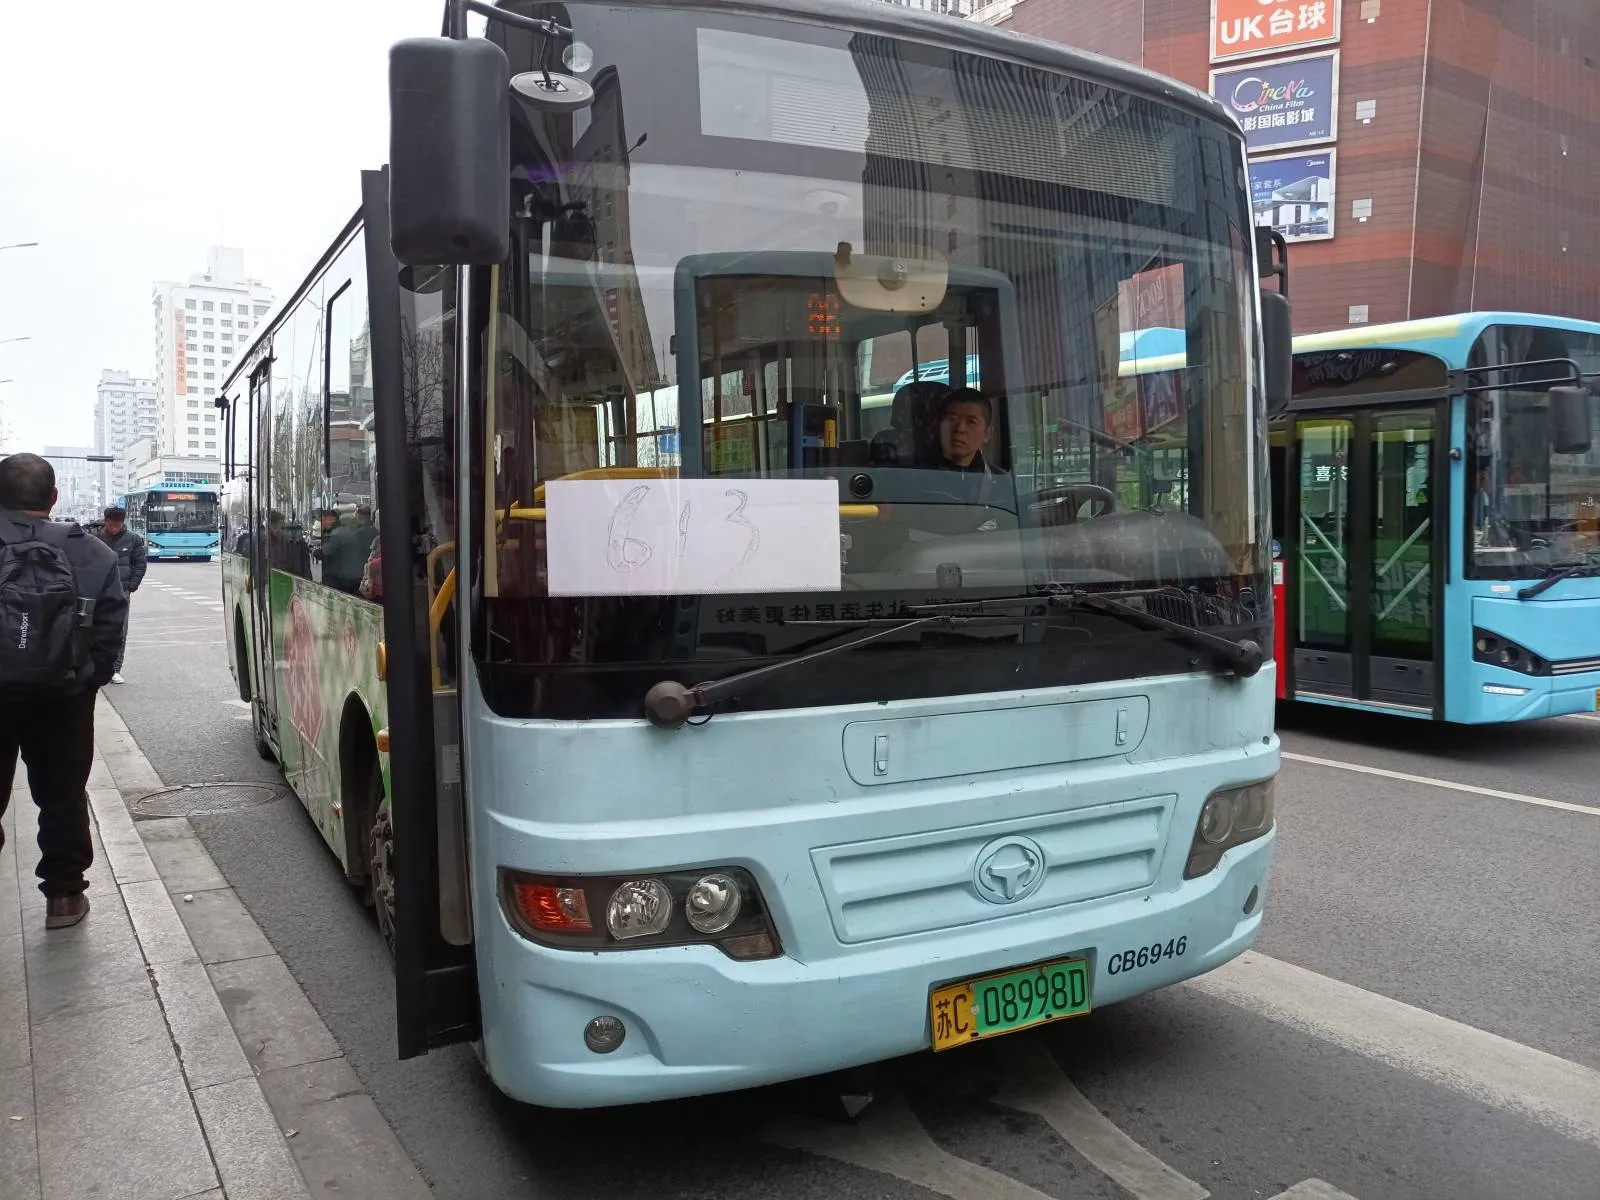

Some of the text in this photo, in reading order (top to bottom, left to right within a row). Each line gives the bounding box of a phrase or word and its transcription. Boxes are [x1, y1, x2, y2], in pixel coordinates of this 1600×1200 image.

[1240, 107, 1315, 132] 影国际影城
[1259, 100, 1305, 112] China Film
[606, 484, 761, 586] 613
[1107, 936, 1187, 975] CB6946
